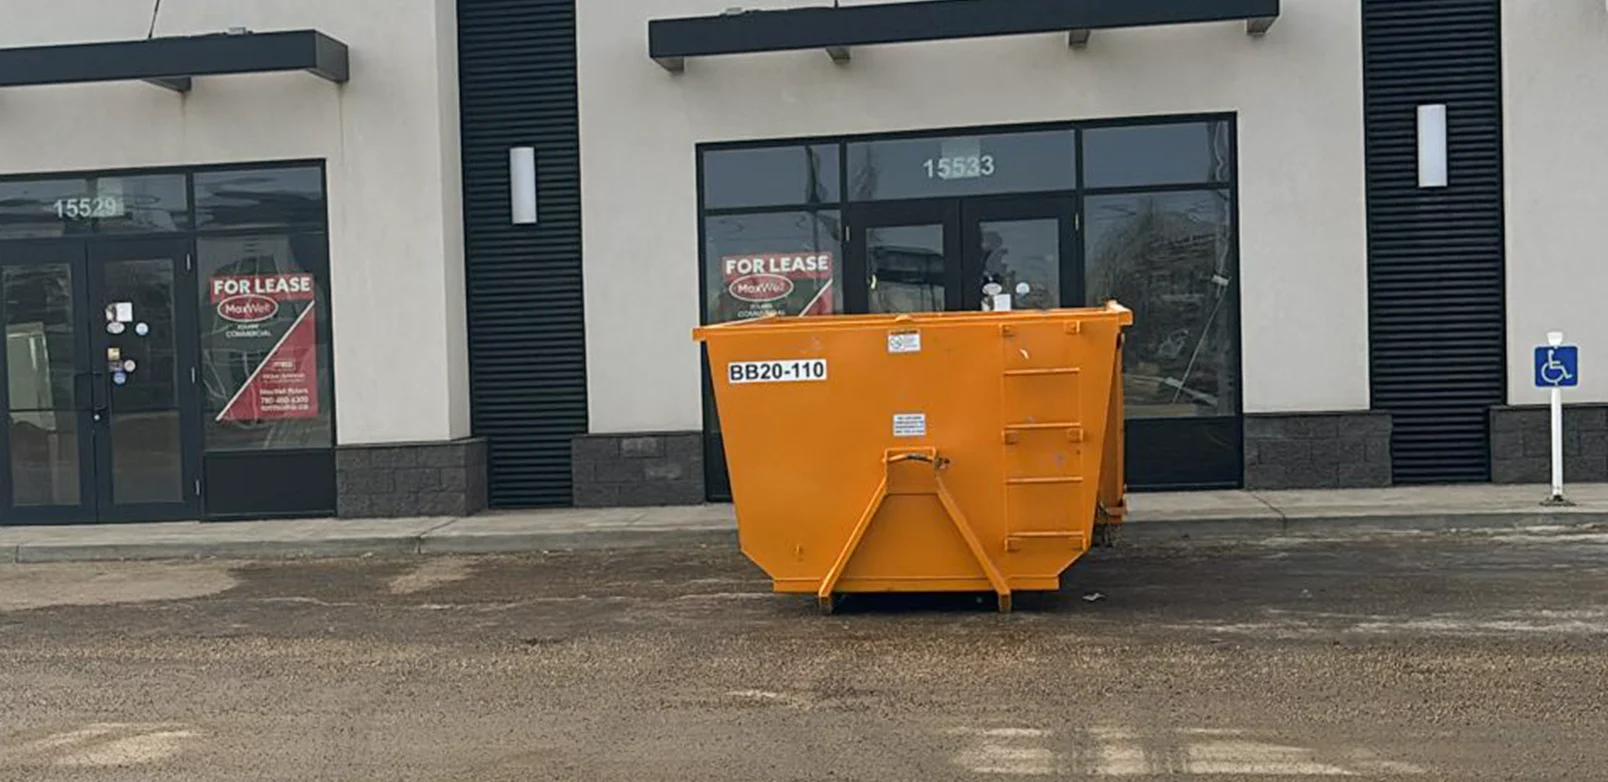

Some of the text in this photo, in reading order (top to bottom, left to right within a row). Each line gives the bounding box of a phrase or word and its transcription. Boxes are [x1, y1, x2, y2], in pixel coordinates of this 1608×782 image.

[923, 155, 994, 179] 15533
[54, 197, 117, 218] 15529
[725, 255, 829, 275] FOR LEASE
[214, 276, 312, 295] FOR LEASE
[730, 361, 824, 381] BB20-110
